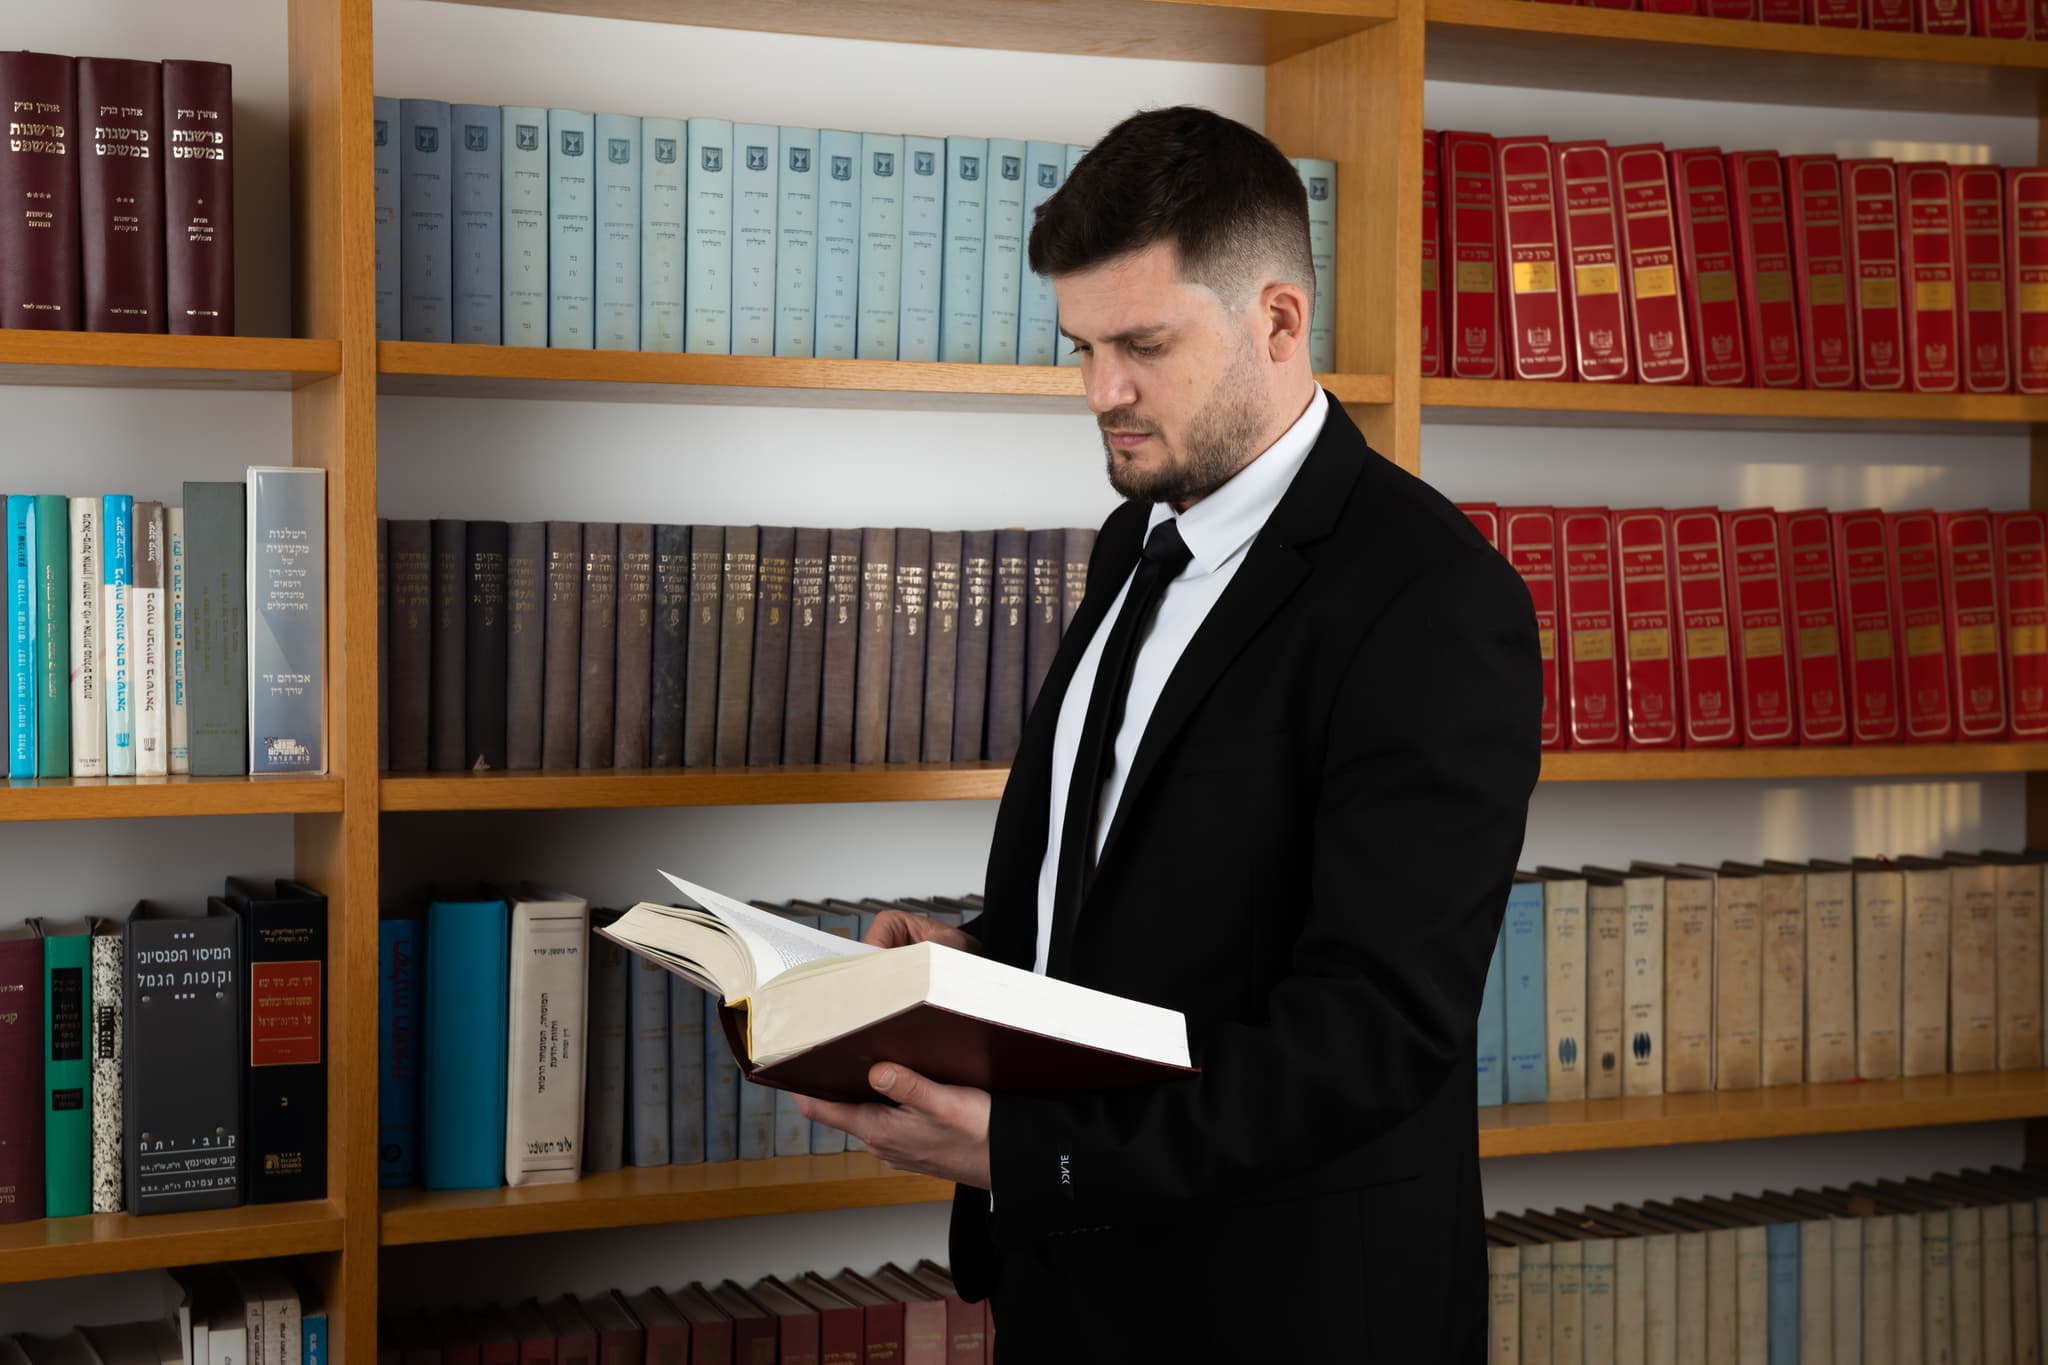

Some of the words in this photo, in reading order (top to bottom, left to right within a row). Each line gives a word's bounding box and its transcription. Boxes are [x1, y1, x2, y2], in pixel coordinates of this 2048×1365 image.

[14, 101, 33, 112] ברק
[36, 101, 60, 114] אהרן
[100, 106, 118, 117] ברק
[121, 106, 143, 117] אהרן
[177, 109, 194, 120] ברק
[197, 109, 218, 120] אהרן
[9, 122, 65, 138] פרשנות
[95, 126, 149, 142] פרשנות
[172, 129, 223, 144] פרשנות
[10, 139, 66, 155] במשפט
[95, 143, 150, 158] במשפט
[173, 145, 225, 160] במשפט
[269, 528, 307, 540] רשלנות
[266, 542, 309, 556] מקצועית
[115, 568, 124, 599] ביטוח
[145, 592, 155, 624] ביטוח
[116, 603, 125, 639] תאונות
[145, 628, 155, 664] חבויות
[116, 643, 125, 666] אדם
[277, 673, 311, 684] אברהם
[116, 670, 126, 712] בישראל
[145, 669, 155, 712] בישראל
[270, 687, 283, 696] דין
[286, 686, 303, 696] עורך
[138, 949, 188, 964] הפנסיוני
[193, 947, 231, 961] המיסוי
[138, 973, 175, 987] הגמל
[182, 970, 232, 988] וקופות
[184, 1157, 218, 1170] שטיינמץ
[219, 1155, 236, 1166] קובי
[185, 1178, 213, 1188] עמינח
[217, 1176, 236, 1186] ראם
